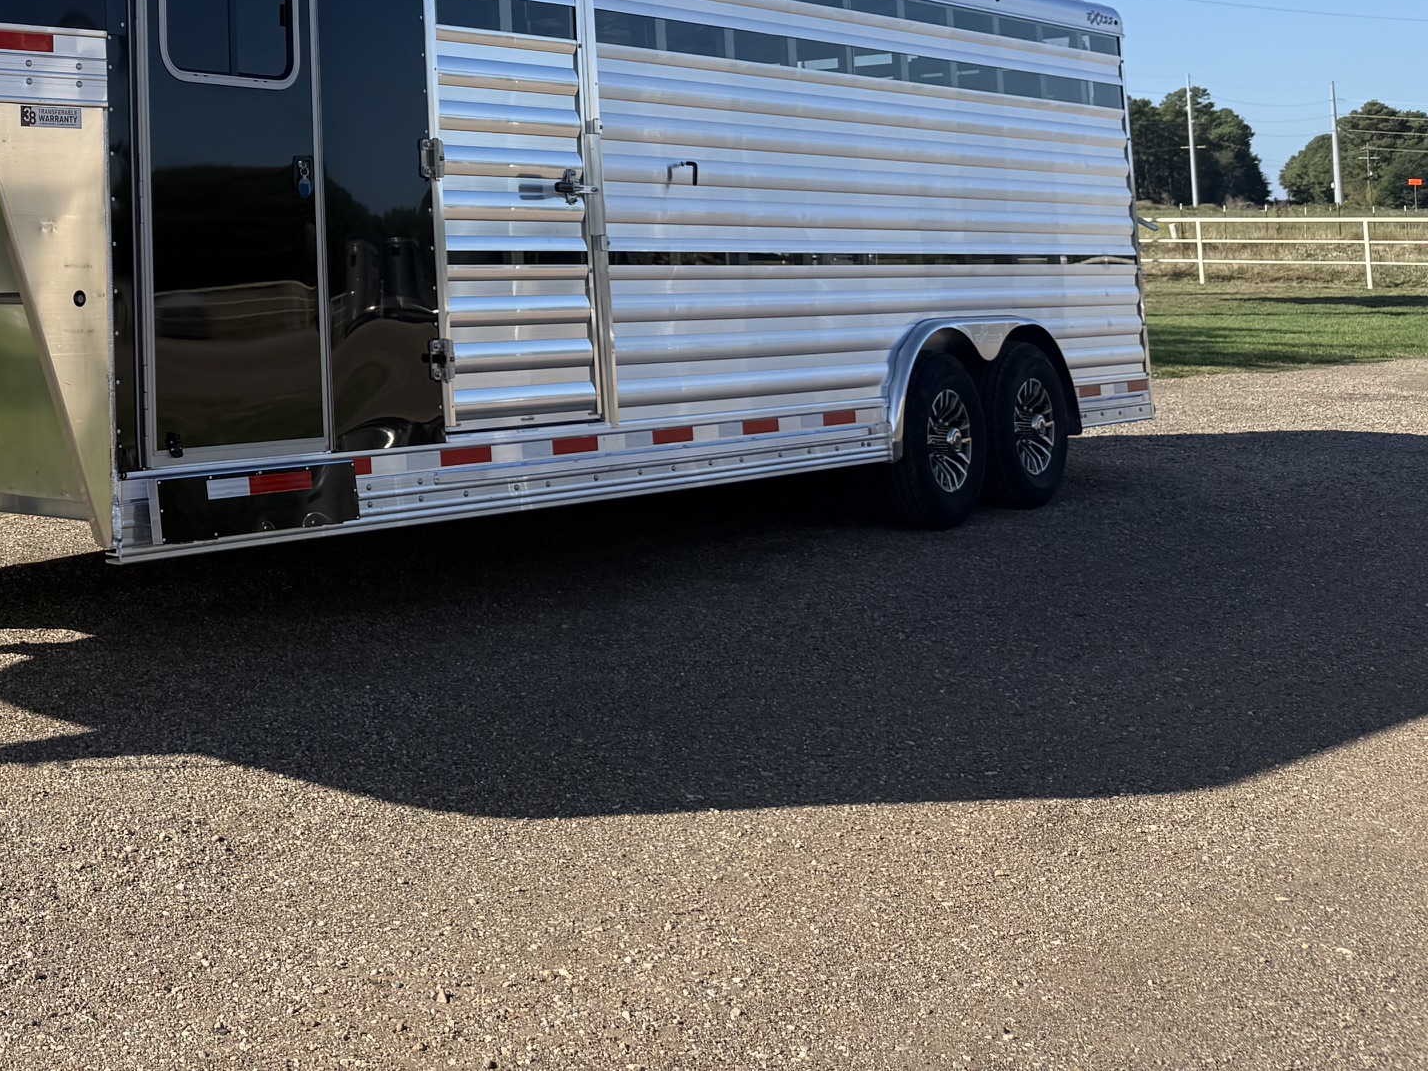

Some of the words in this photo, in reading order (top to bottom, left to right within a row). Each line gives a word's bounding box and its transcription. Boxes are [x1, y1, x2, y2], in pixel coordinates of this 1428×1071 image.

[23, 107, 36, 125] 38
[38, 108, 77, 116] TRANSFERABLE
[38, 115, 78, 124] WARRANTY
